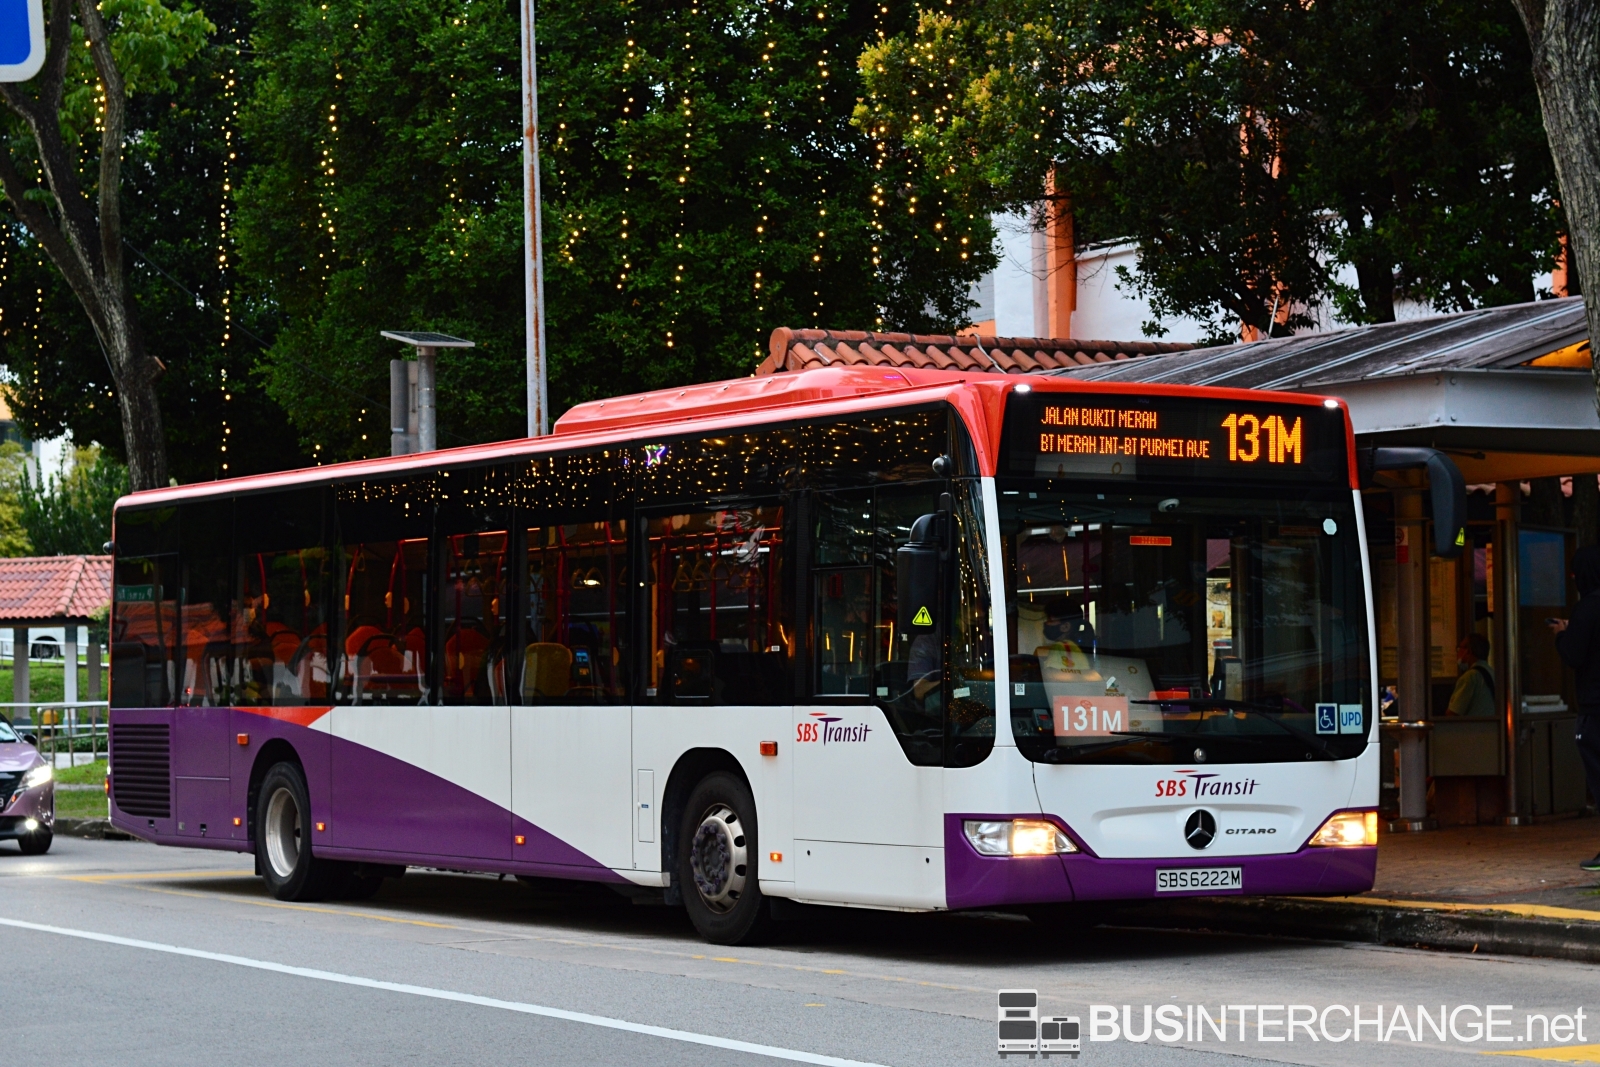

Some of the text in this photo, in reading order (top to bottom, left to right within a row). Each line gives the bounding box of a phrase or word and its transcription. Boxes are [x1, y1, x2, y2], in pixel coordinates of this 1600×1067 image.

[1041, 406, 1157, 429] JALAN BUKIT MERAH
[1040, 433, 1210, 458] BT MERAH INT-BT PURMEI AVE
[1221, 413, 1301, 464] 131M
[1061, 705, 1122, 732] 131M
[1341, 711, 1362, 726] UPD
[796, 717, 873, 746] SBS Transit
[1155, 773, 1261, 799] SBS Transit
[1225, 827, 1277, 835] CITARO
[1158, 870, 1241, 888] SBS6222M
